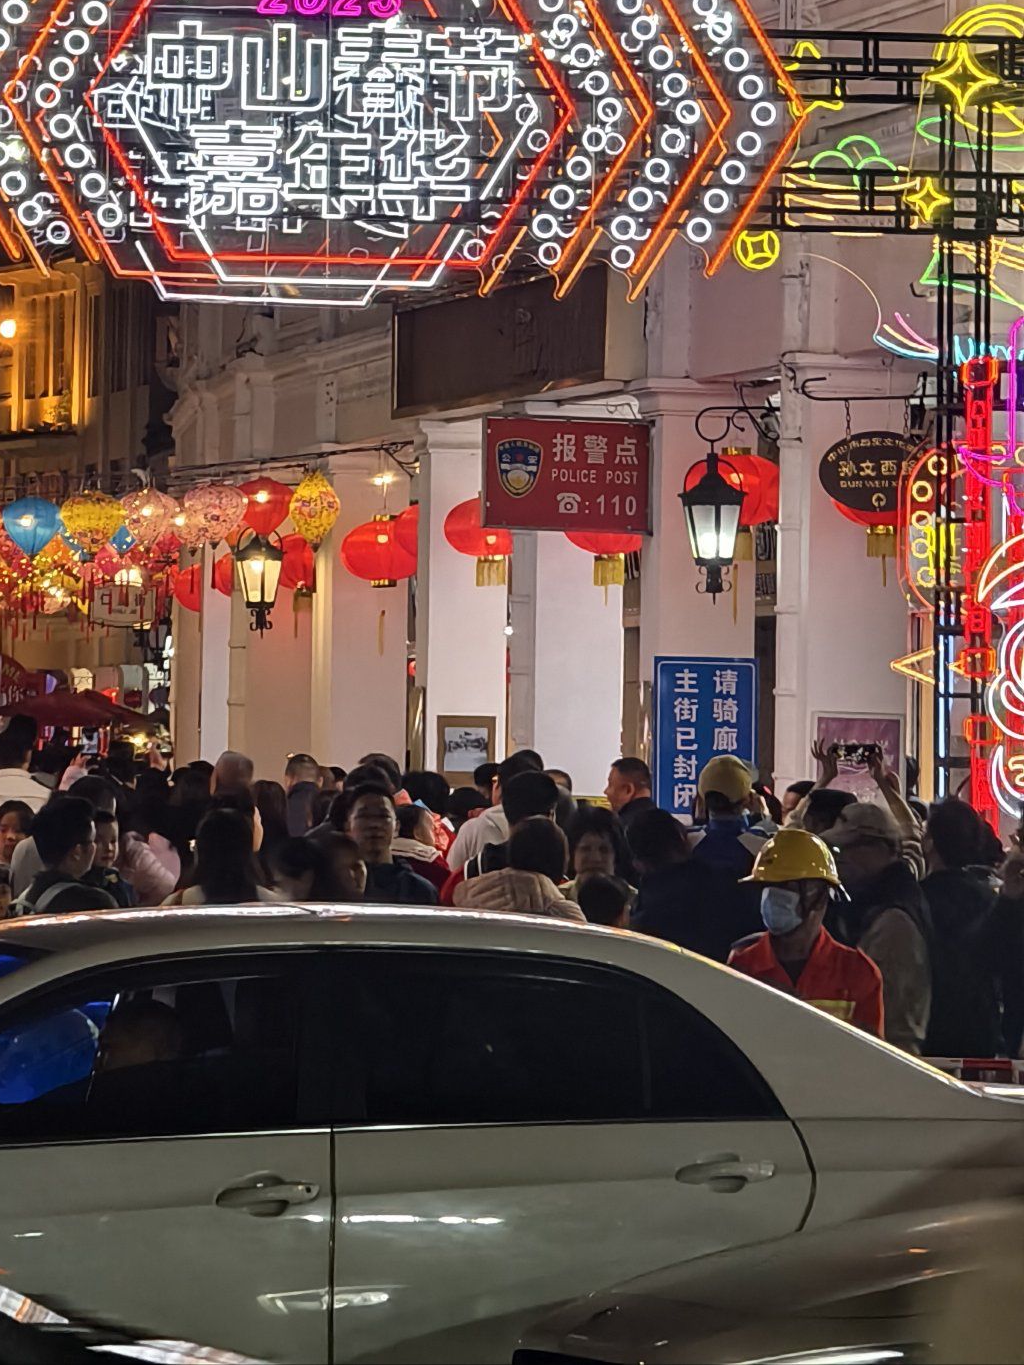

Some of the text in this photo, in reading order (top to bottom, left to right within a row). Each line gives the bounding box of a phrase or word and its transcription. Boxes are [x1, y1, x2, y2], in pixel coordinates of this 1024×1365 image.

[146, 20, 521, 122] 中山春节
[188, 120, 471, 221] 嘉年华
[551, 468, 638, 485] POLICE POST
[552, 433, 638, 465] 报警点
[673, 668, 699, 808] 主街已封闭
[712, 669, 739, 752] 请骑廊
